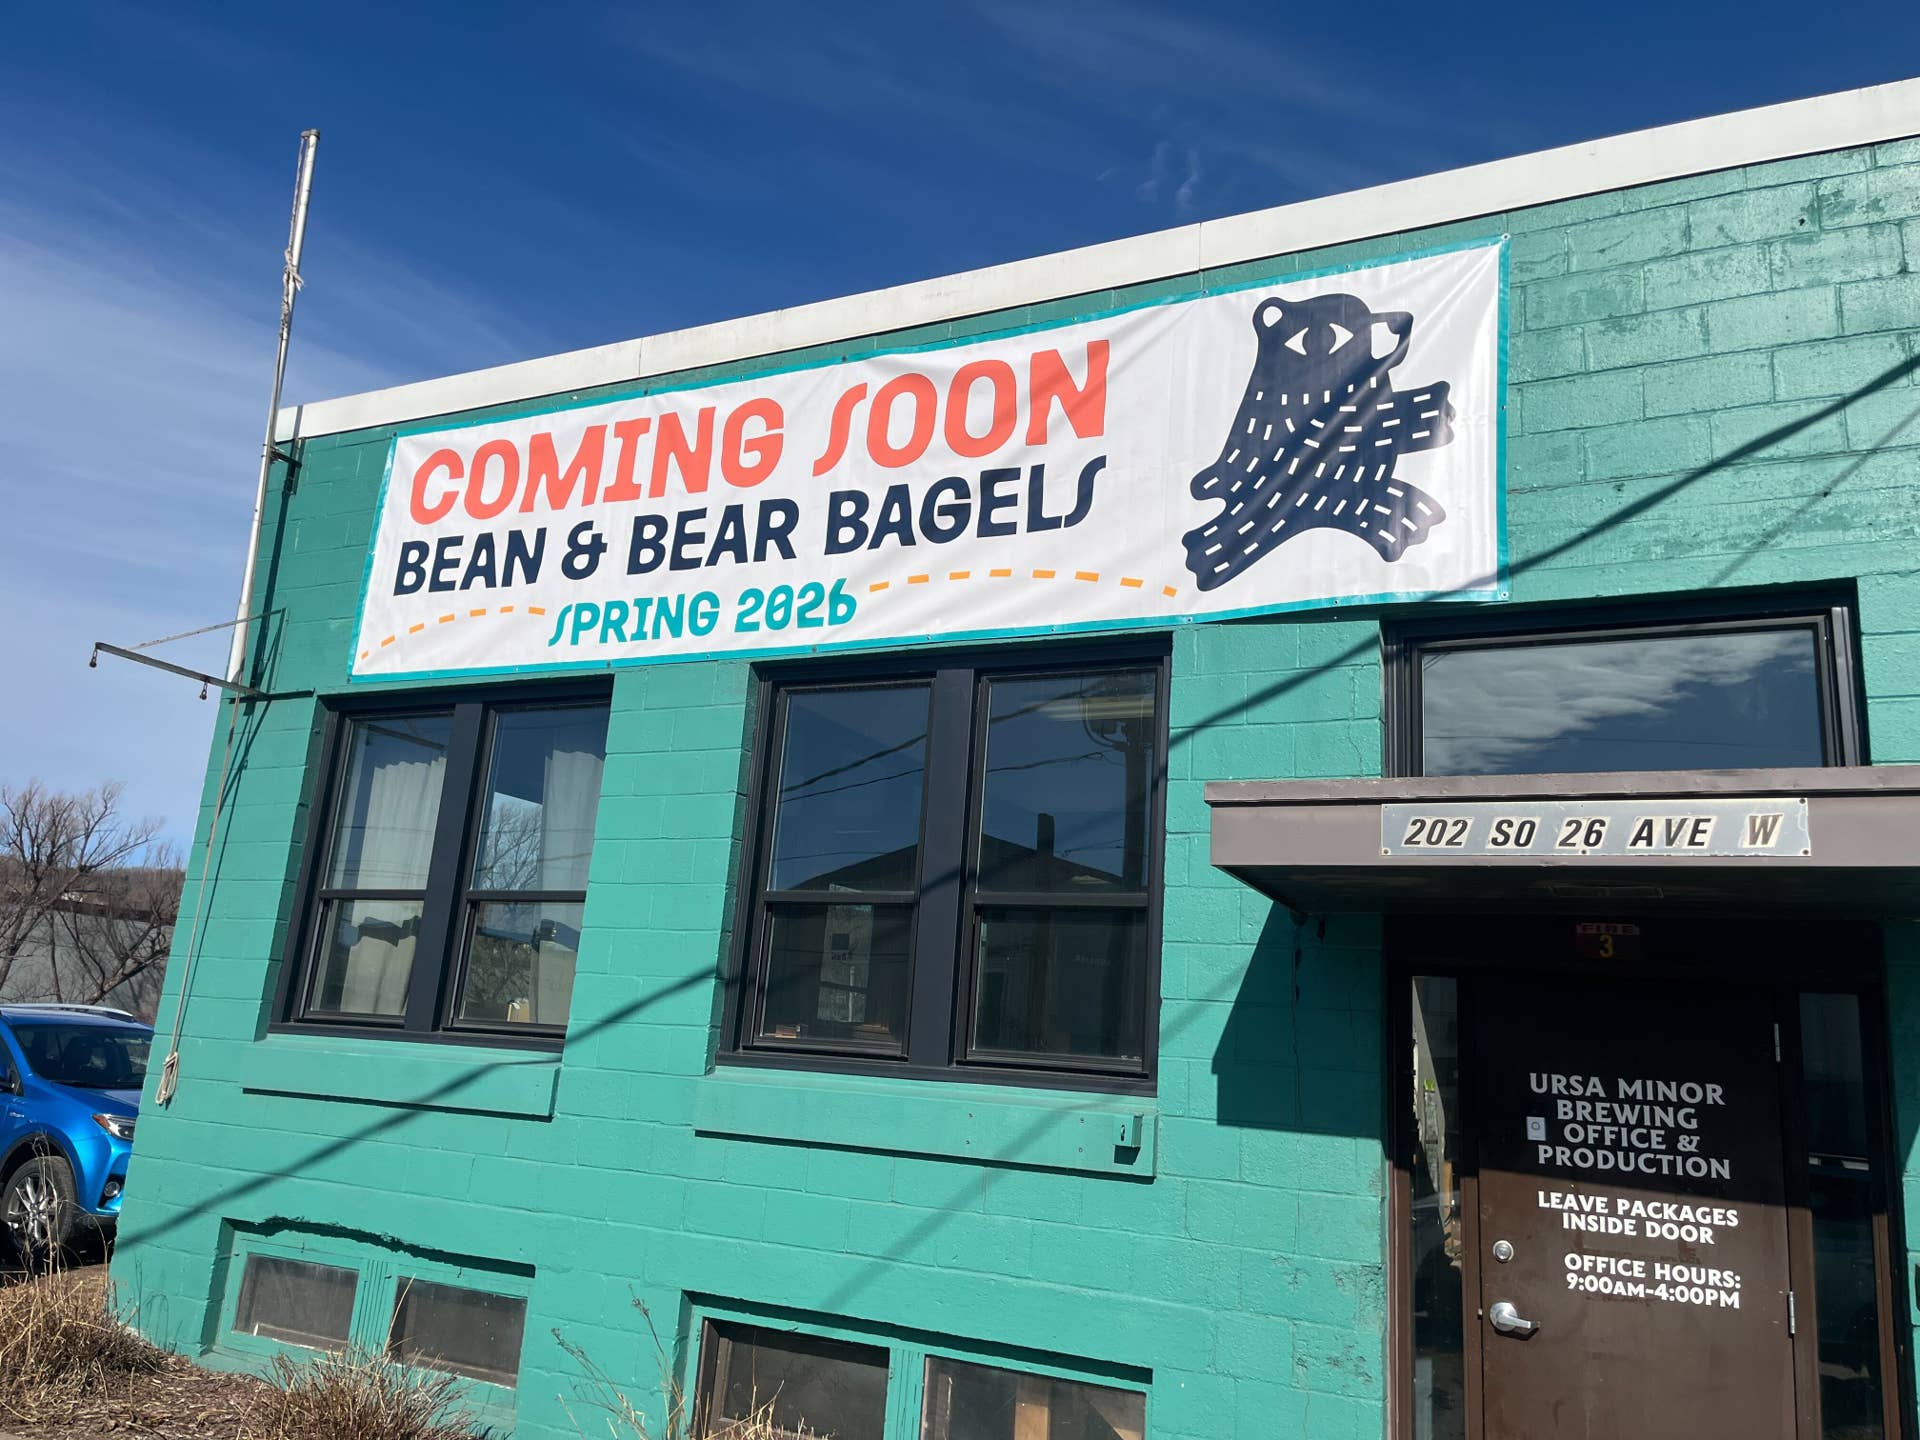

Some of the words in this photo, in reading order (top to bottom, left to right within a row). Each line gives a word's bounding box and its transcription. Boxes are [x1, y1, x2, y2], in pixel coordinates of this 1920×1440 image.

[410, 397, 785, 525] COMING
[812, 339, 1110, 477] SOON
[393, 527, 547, 596] BEAN
[561, 520, 608, 581] &
[626, 498, 800, 575] BEAR
[824, 455, 1107, 556] BAGELS
[547, 590, 721, 647] SPRING
[734, 577, 858, 634] 2026
[1404, 818, 1469, 847] 202
[1491, 818, 1536, 847] SO
[1558, 818, 1606, 848] 26
[1629, 817, 1712, 848] AVE
[1747, 814, 1783, 848] W
[1599, 934, 1615, 958] 3
[1529, 1072, 1607, 1098] URSA
[1617, 1078, 1726, 1106] MINOR
[1556, 1099, 1699, 1130] BREWING
[1563, 1122, 1667, 1151] OFFICE
[1676, 1134, 1701, 1153] &
[1537, 1144, 1732, 1180] PRODUCTION
[1537, 1190, 1609, 1214] LEAVE
[1616, 1198, 1739, 1227] PACKAGES
[1562, 1212, 1637, 1236] INSIDE
[1645, 1220, 1715, 1245] DOOR
[1564, 1252, 1646, 1278] OFFICE
[1654, 1262, 1742, 1290] HOURS:
[1566, 1272, 1741, 1309] 9:00AM-4:00PM
